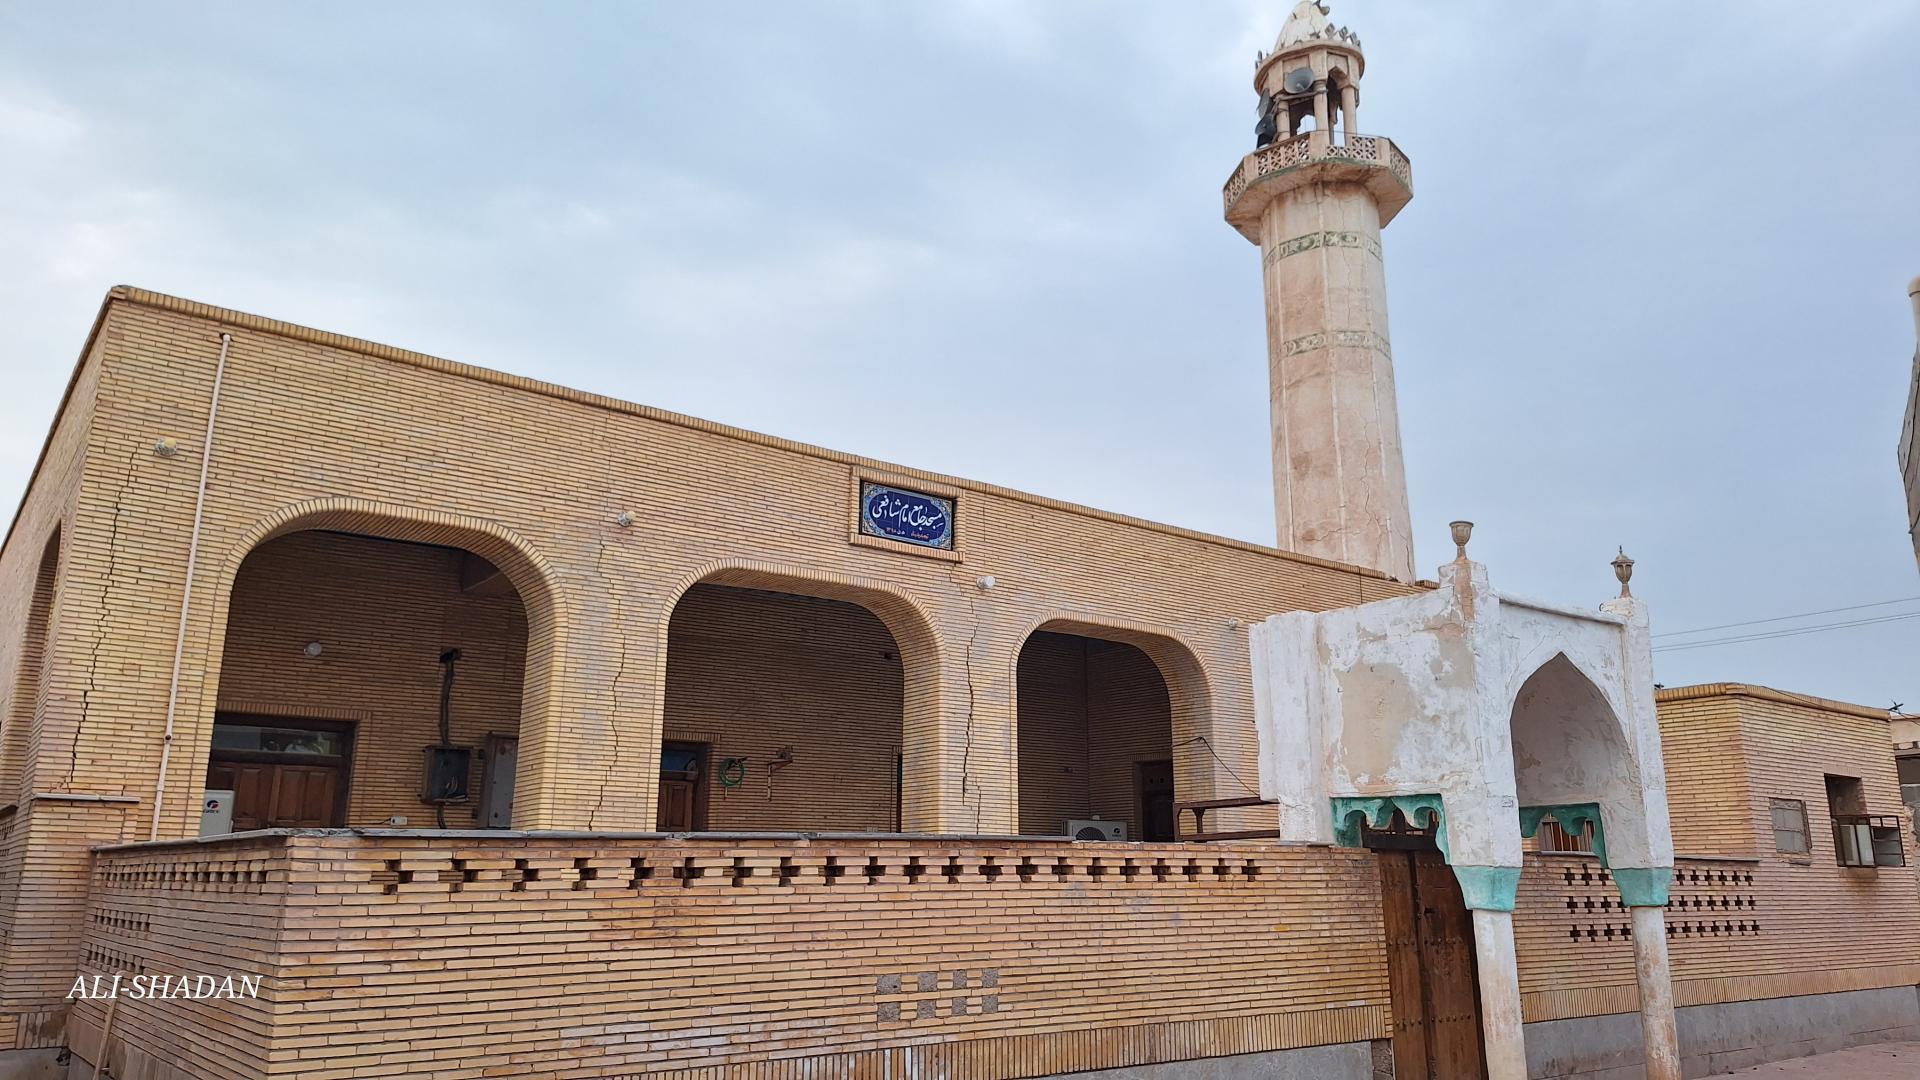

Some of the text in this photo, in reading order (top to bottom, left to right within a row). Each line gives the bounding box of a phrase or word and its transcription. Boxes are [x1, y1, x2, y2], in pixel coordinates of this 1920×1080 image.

[898, 503, 911, 528] امام
[909, 504, 928, 532] جامع
[924, 511, 945, 531] مسجد
